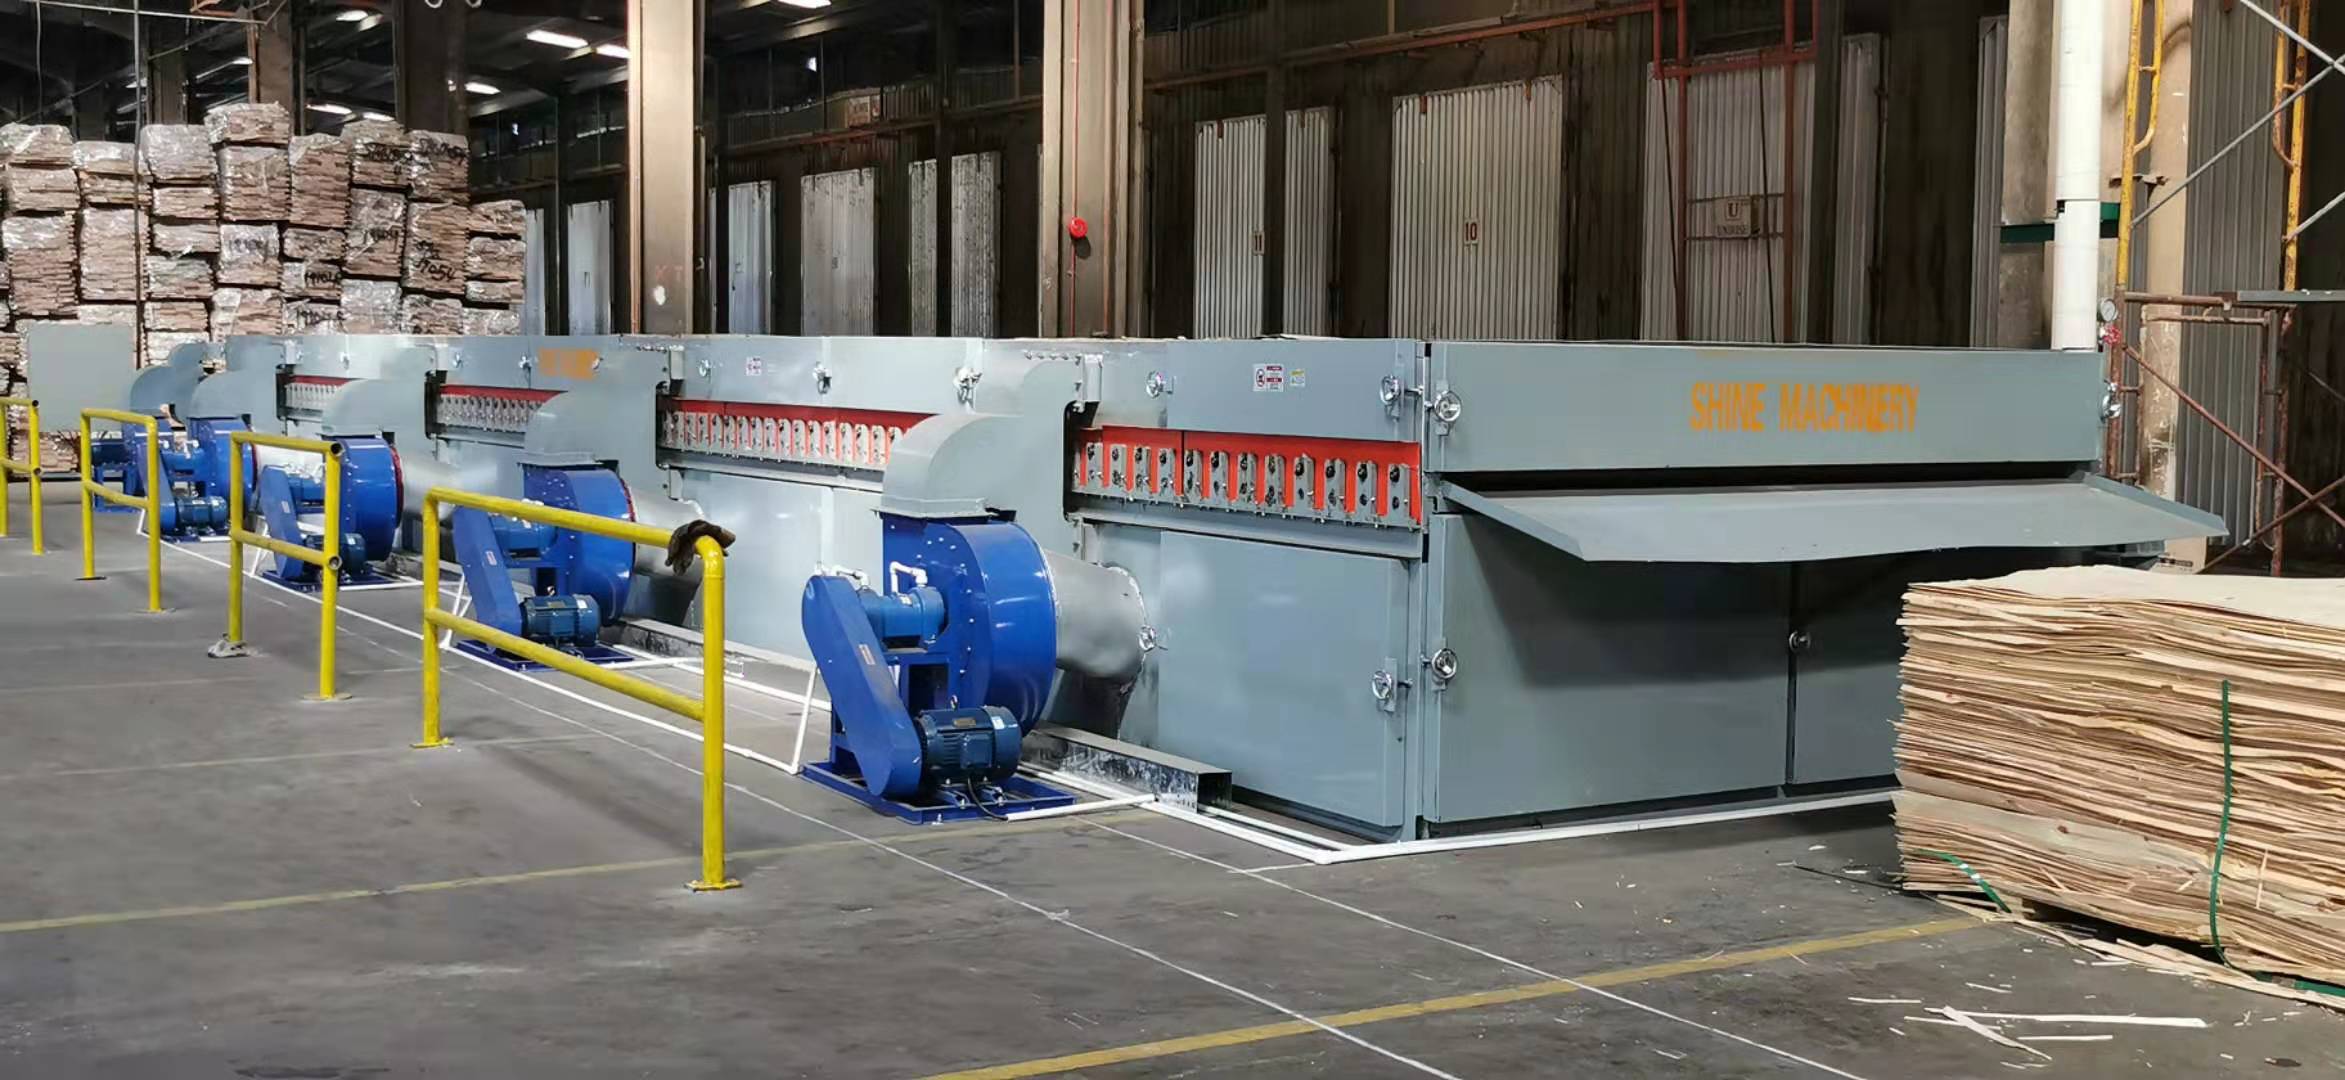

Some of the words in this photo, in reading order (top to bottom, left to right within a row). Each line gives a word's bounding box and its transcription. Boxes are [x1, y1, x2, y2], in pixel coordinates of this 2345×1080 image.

[1465, 222, 1477, 241] 10
[1254, 234, 1262, 251] 11
[1689, 382, 1767, 433] SHINE
[1778, 383, 1920, 434] MACHINERY
